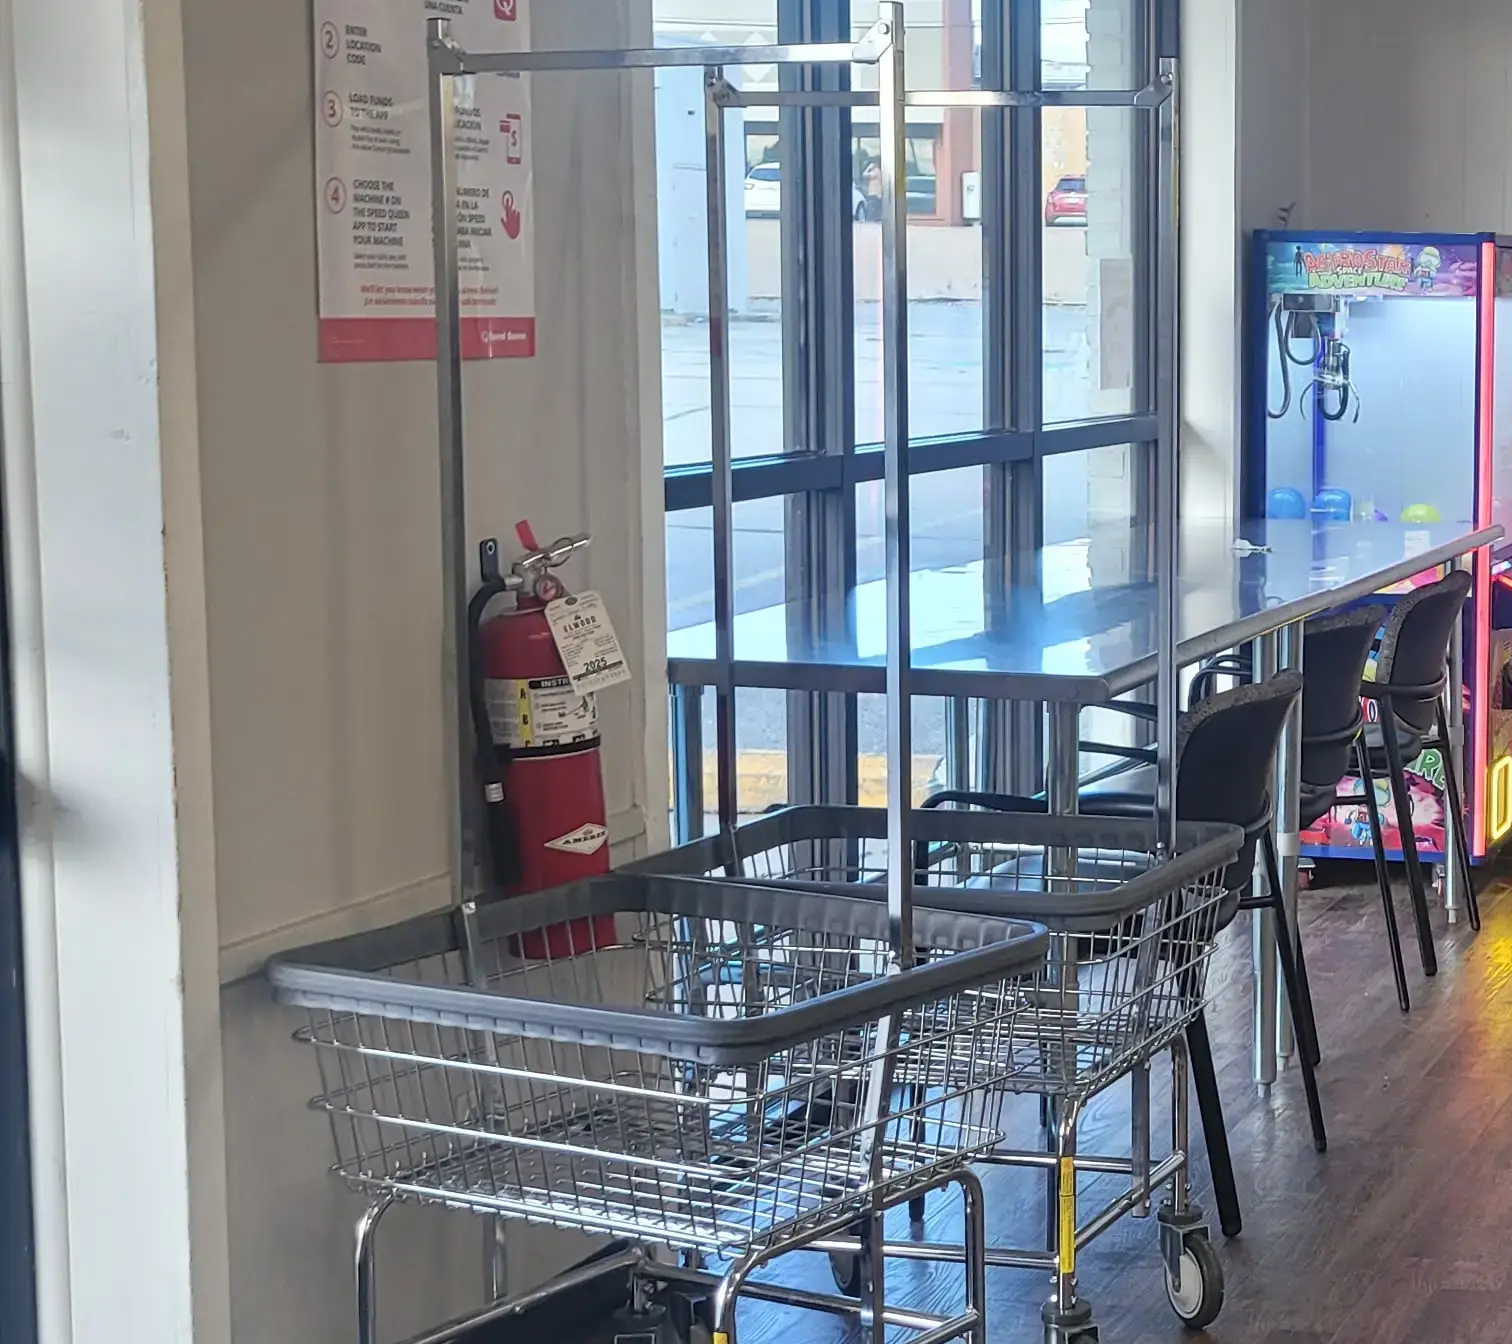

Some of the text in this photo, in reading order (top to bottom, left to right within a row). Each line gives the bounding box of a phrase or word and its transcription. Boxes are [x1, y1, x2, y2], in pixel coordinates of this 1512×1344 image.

[345, 25, 368, 37] ENTER
[325, 30, 334, 49] 2
[346, 39, 382, 53] LOCATION
[346, 53, 366, 65] CODE
[349, 92, 393, 107] LOAD FUNDS
[327, 99, 336, 118] 3
[353, 179, 394, 192] CHOOSE THE
[331, 185, 339, 205] 4
[353, 193, 384, 204] MACHINE
[353, 206, 410, 220] THE SPEED QUEEN
[352, 221, 398, 233] APP TO START
[353, 235, 403, 247] YOUR MACHINE
[1308, 272, 1409, 292] ADVENTURE
[563, 615, 597, 632] ELWOOD
[583, 656, 608, 672] 2025
